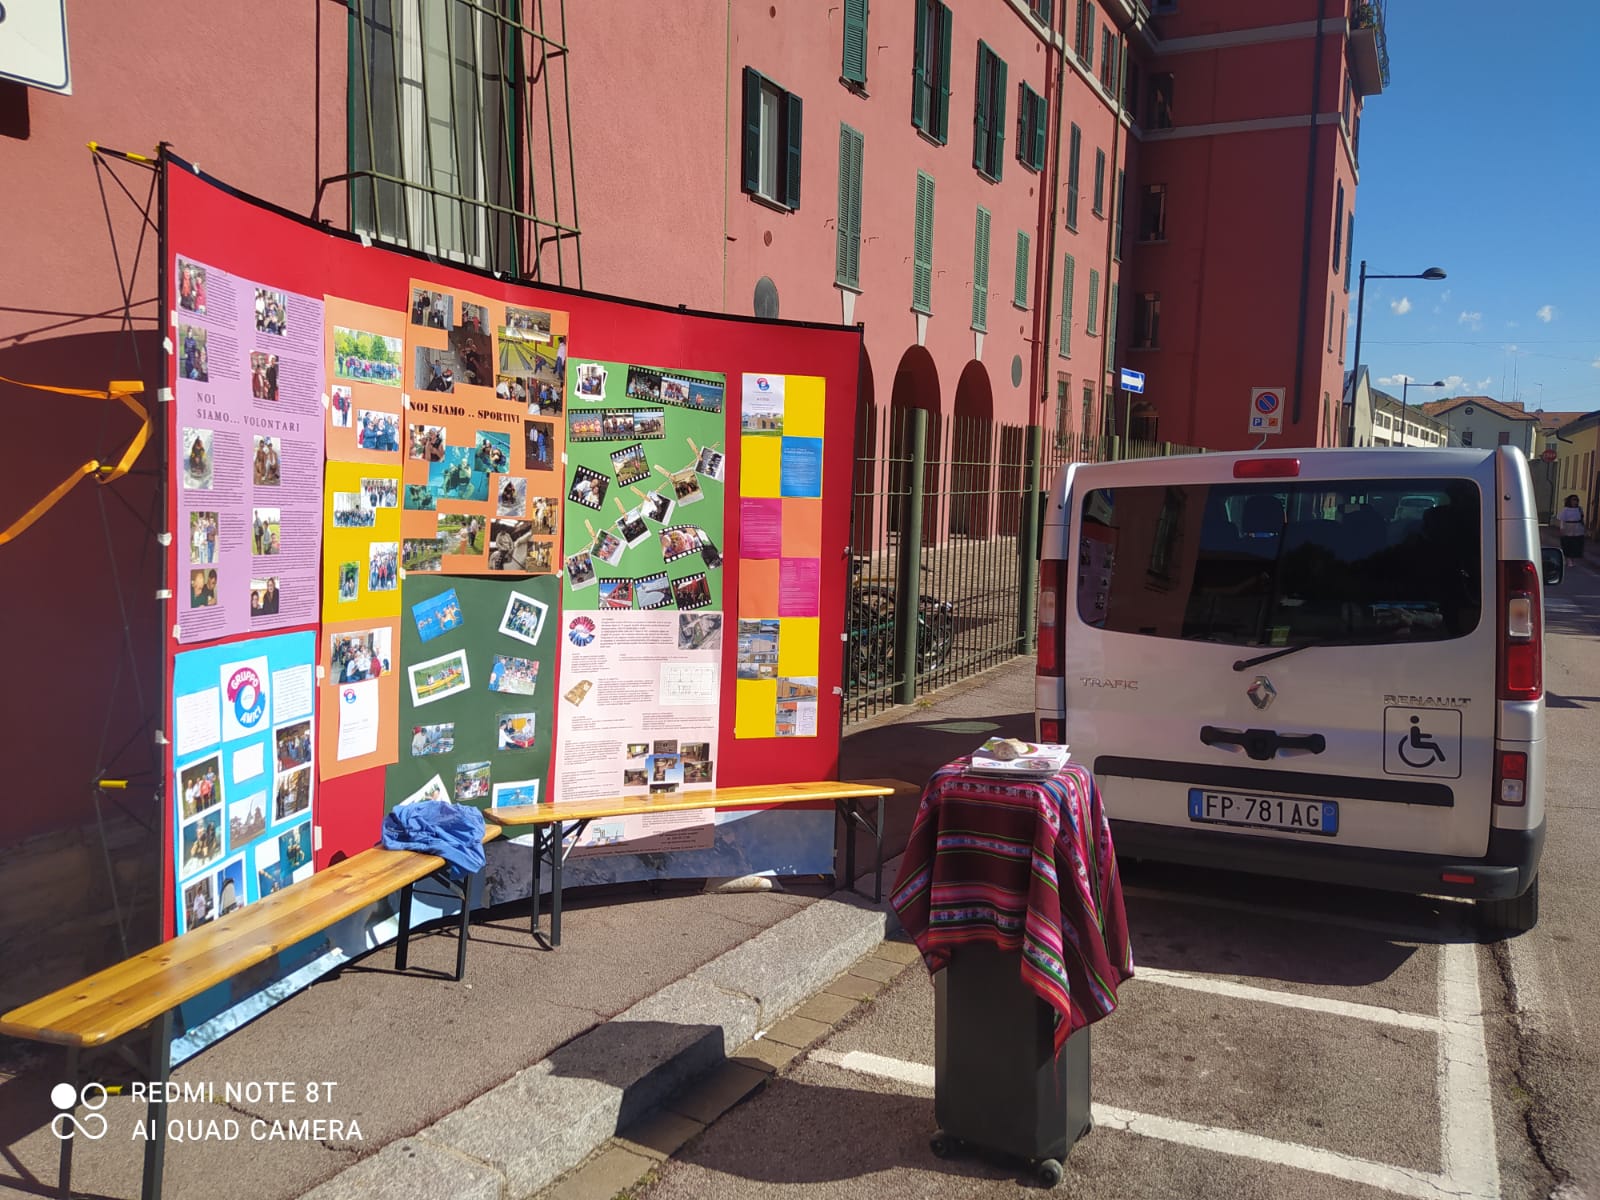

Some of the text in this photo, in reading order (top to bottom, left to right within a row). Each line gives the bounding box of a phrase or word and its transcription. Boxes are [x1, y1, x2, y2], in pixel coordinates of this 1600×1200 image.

[197, 392, 216, 405] NOI
[409, 401, 428, 412] NOI
[432, 404, 465, 416] SIAMO
[477, 410, 520, 423] SPORTIVI
[243, 416, 300, 432] VOLONTARI
[231, 671, 259, 690] GRUPPO
[1080, 677, 1138, 690] TRAFIC
[1384, 694, 1472, 708] RENAULT
[240, 705, 262, 724] AMICI
